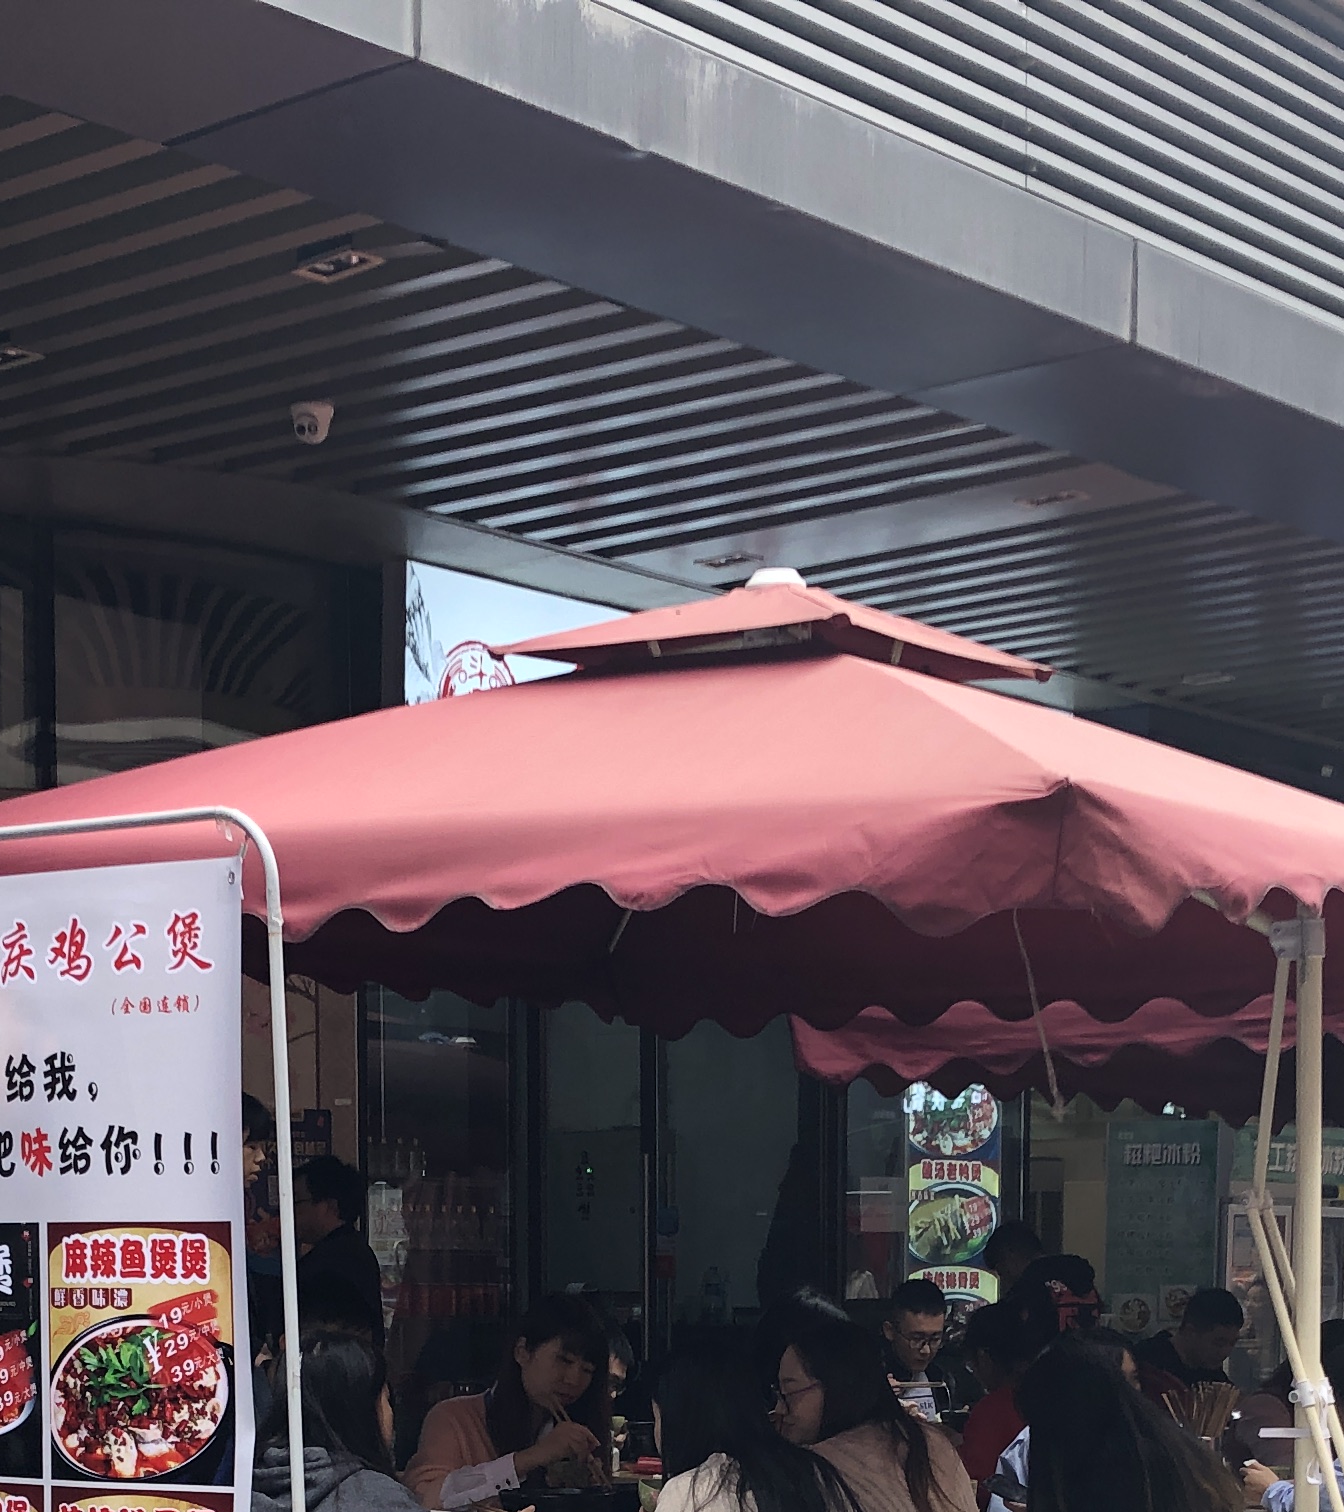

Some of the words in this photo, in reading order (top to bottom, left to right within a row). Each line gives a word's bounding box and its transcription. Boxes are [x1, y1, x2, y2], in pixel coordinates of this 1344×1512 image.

[64, 1237, 210, 1281] 麻辣鱼煲煲
